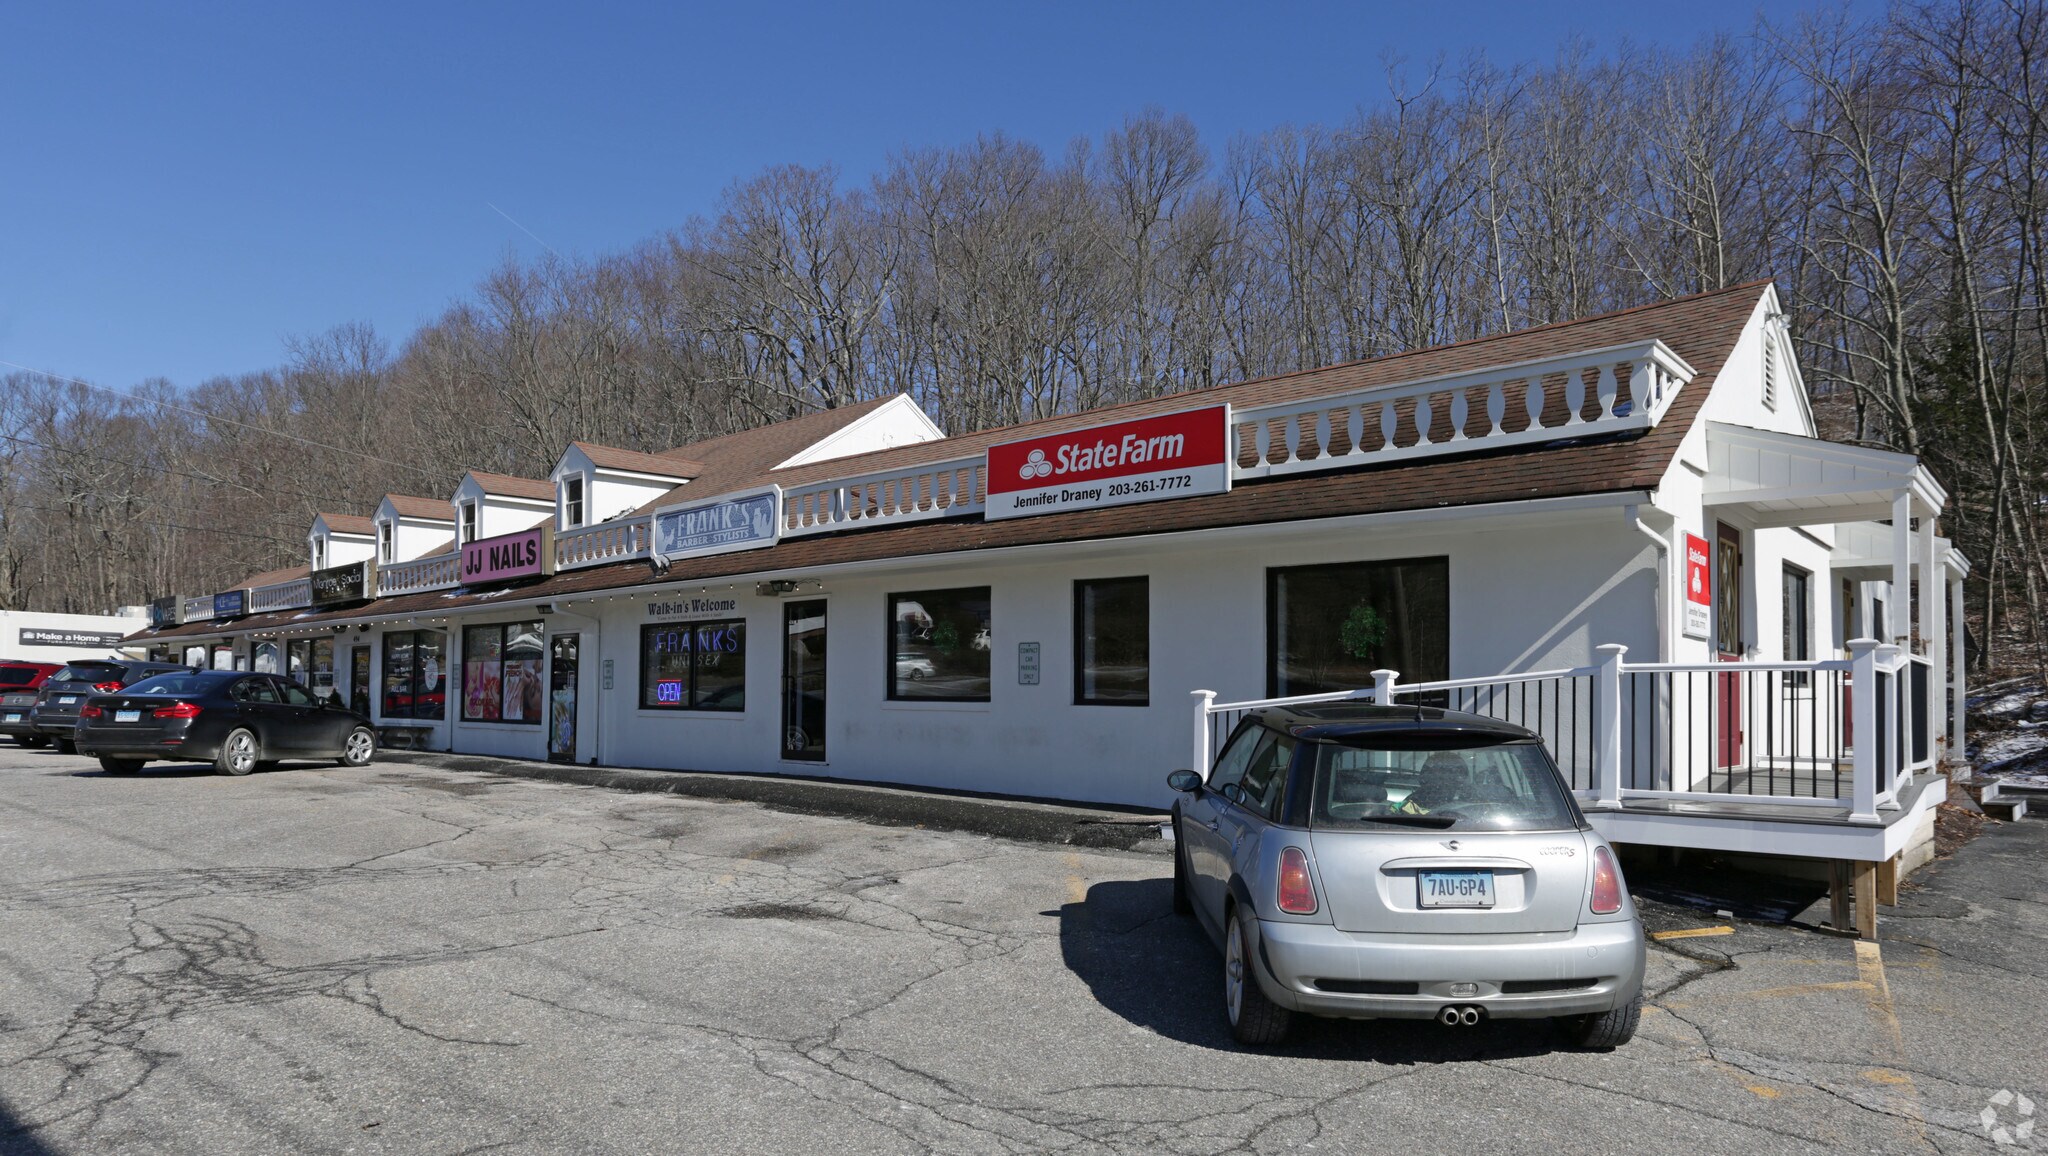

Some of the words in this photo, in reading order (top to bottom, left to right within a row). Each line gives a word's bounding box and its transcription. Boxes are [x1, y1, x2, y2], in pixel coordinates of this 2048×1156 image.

[1013, 491, 1059, 509] Jennifer
[1062, 488, 1103, 505] Draney
[1108, 475, 1192, 500] 203-261-7772
[677, 502, 750, 537] FRANK'S
[677, 536, 708, 549] BARBER
[712, 529, 749, 543] STYLISTS
[466, 549, 482, 575] JJ
[490, 539, 536, 571] NAILS
[341, 569, 362, 584] Social
[648, 601, 689, 616] Walk-in's
[691, 599, 736, 613] Welcome
[36, 632, 63, 640] Make
[73, 635, 101, 643] Home
[655, 629, 737, 653] FRANKS
[657, 682, 682, 702] OPEN
